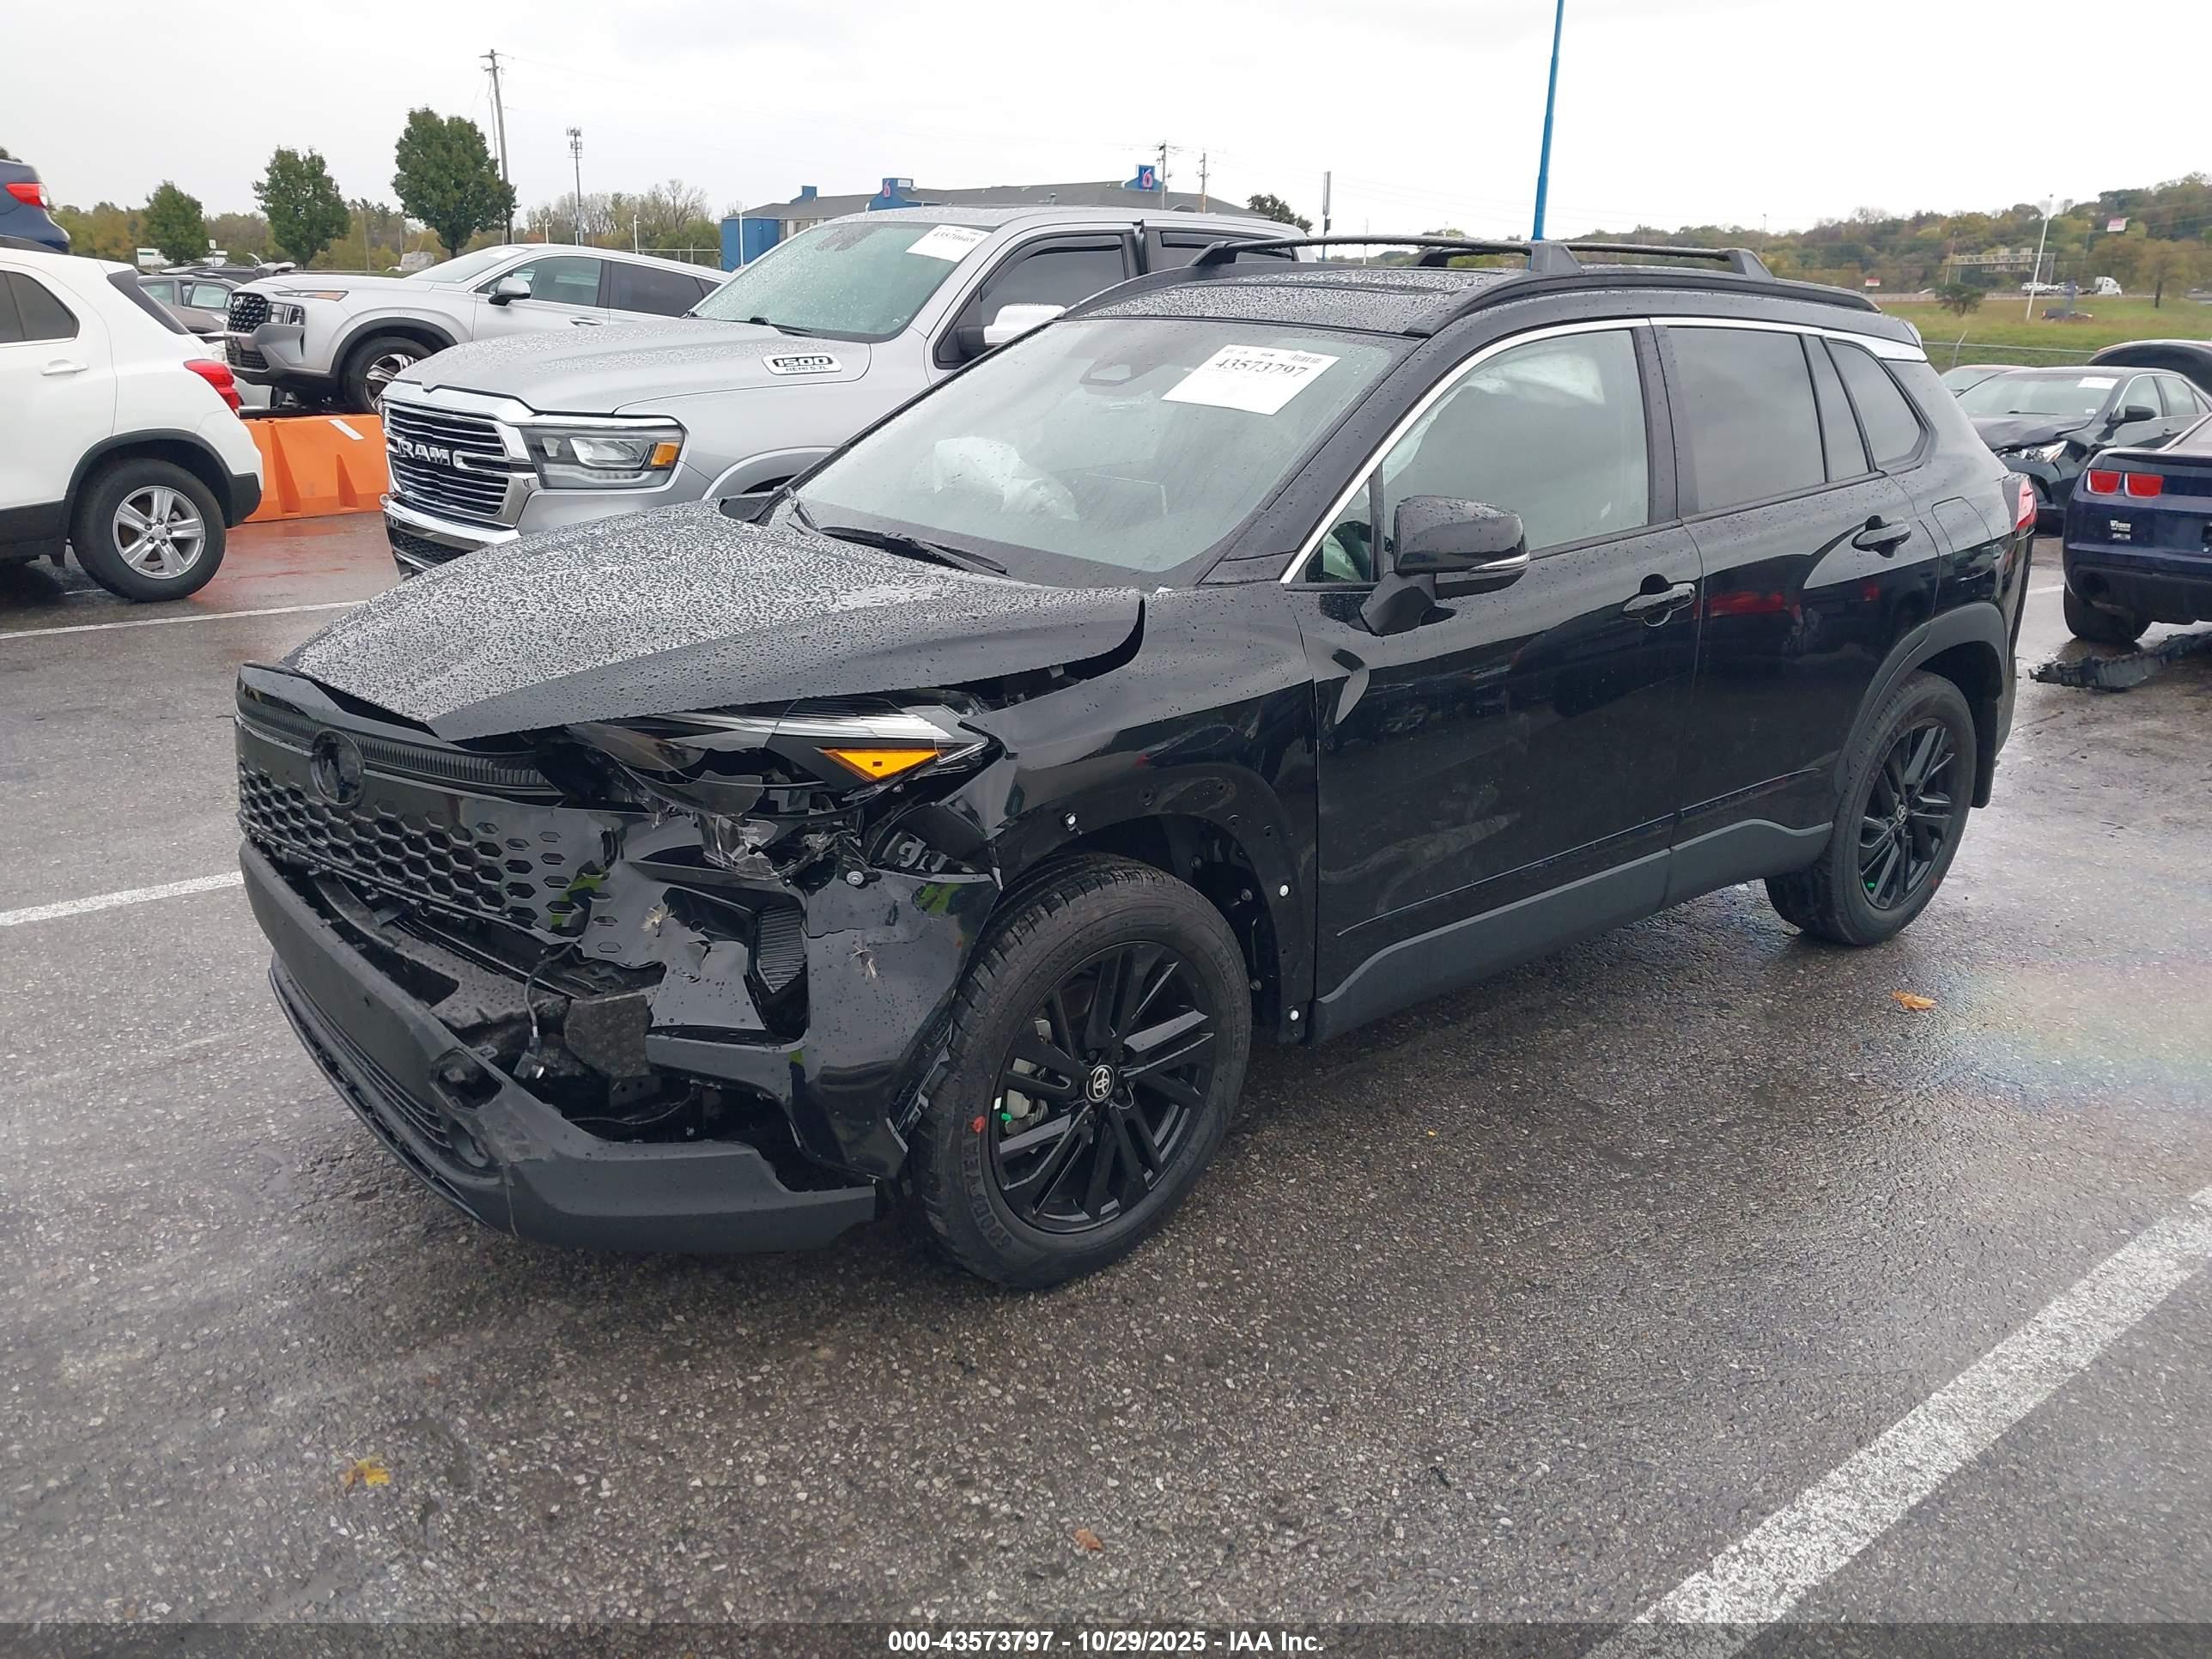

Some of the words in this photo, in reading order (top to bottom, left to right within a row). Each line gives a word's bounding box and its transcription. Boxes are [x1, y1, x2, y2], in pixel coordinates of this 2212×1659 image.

[1142, 169, 1153, 187] 6
[884, 180, 891, 198] 6
[775, 356, 830, 367] 1500
[1215, 357, 1310, 378] 43573797
[398, 439, 451, 466] RAM
